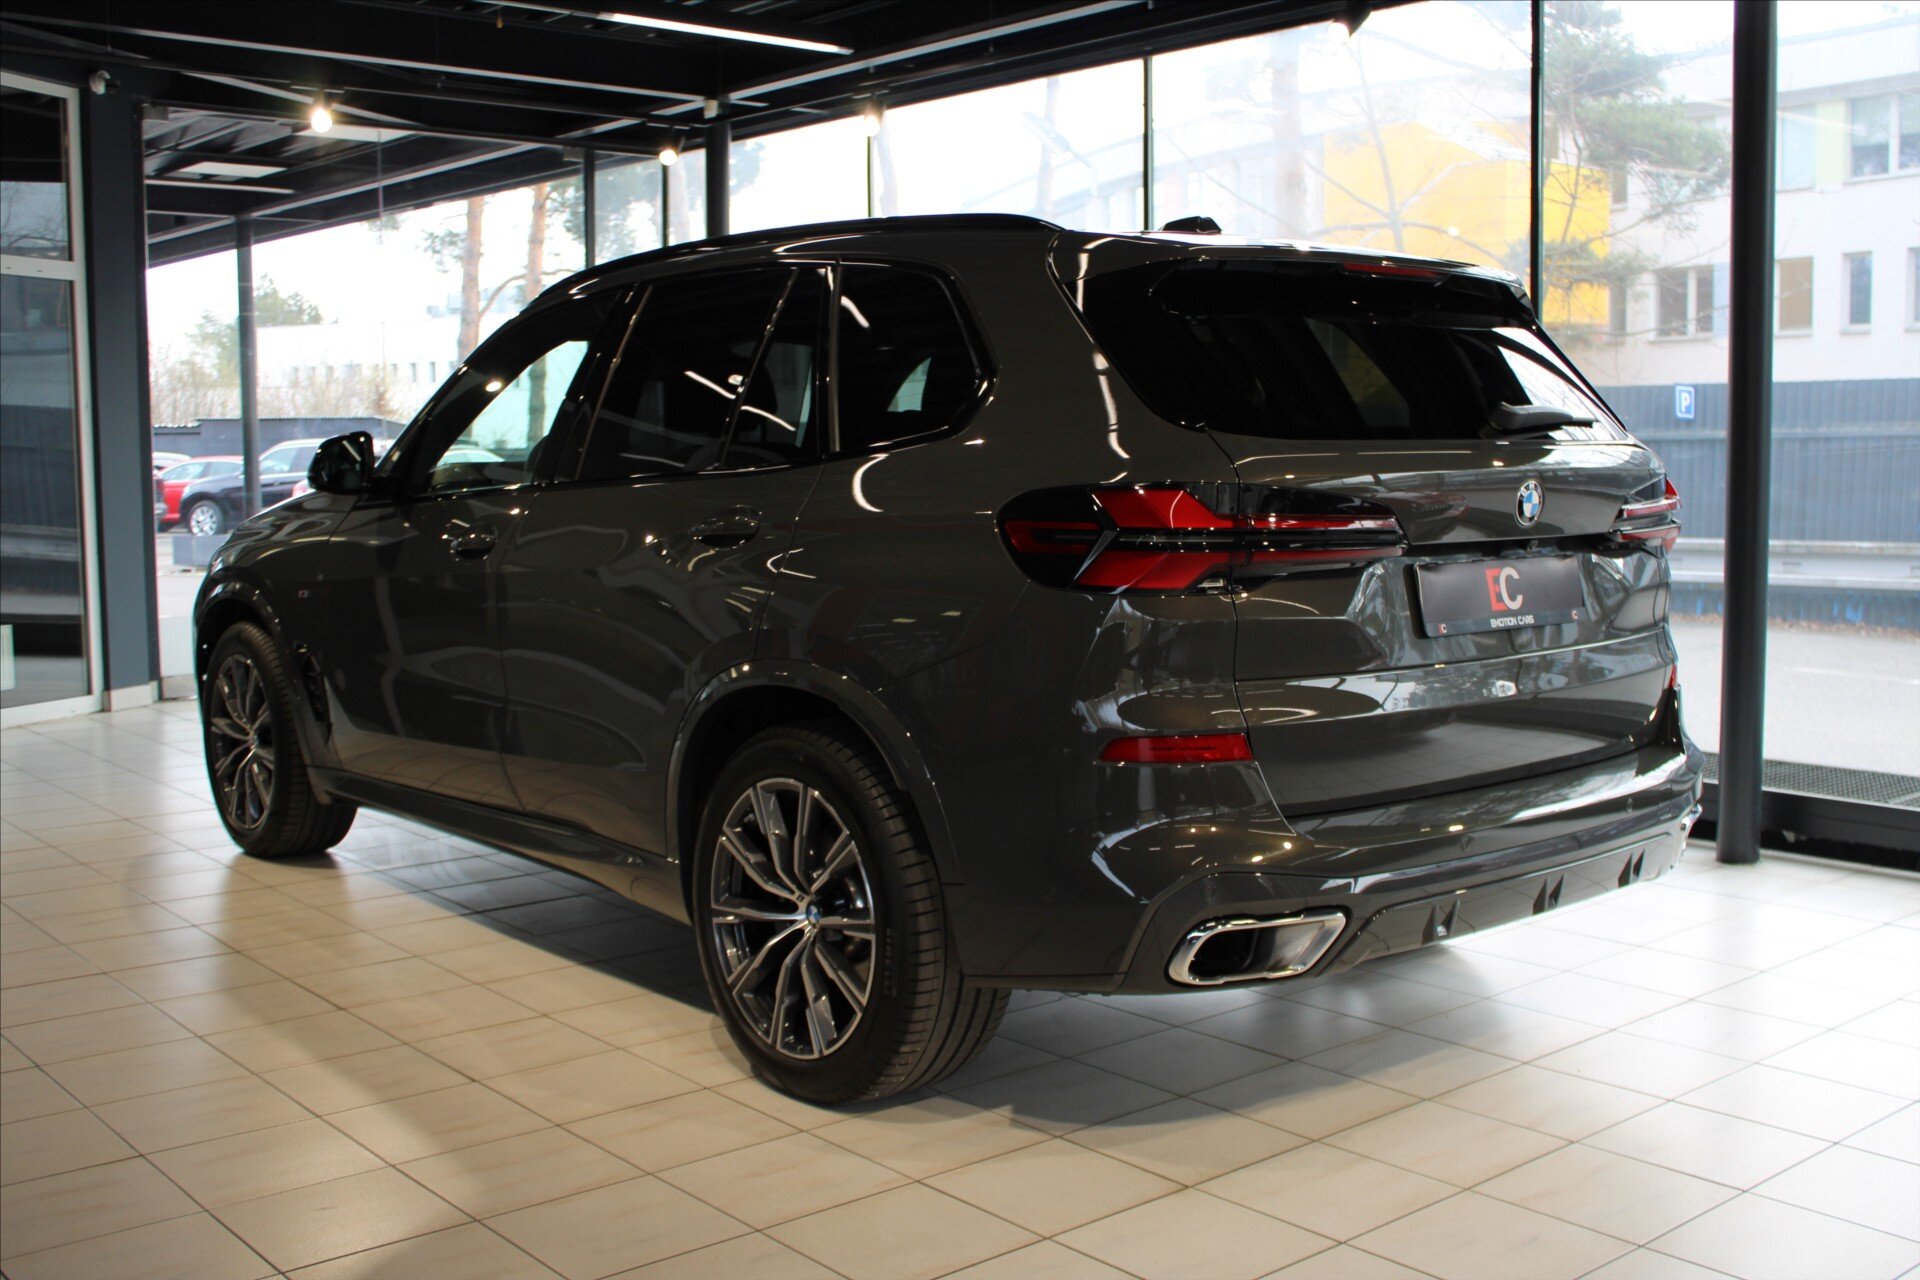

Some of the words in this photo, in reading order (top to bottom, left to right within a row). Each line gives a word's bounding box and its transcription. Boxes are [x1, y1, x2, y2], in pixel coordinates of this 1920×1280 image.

[1680, 392, 1690, 413] P
[1484, 566, 1523, 611] EC
[1490, 616, 1517, 628] EMOTION
[1518, 614, 1534, 625] CARS
